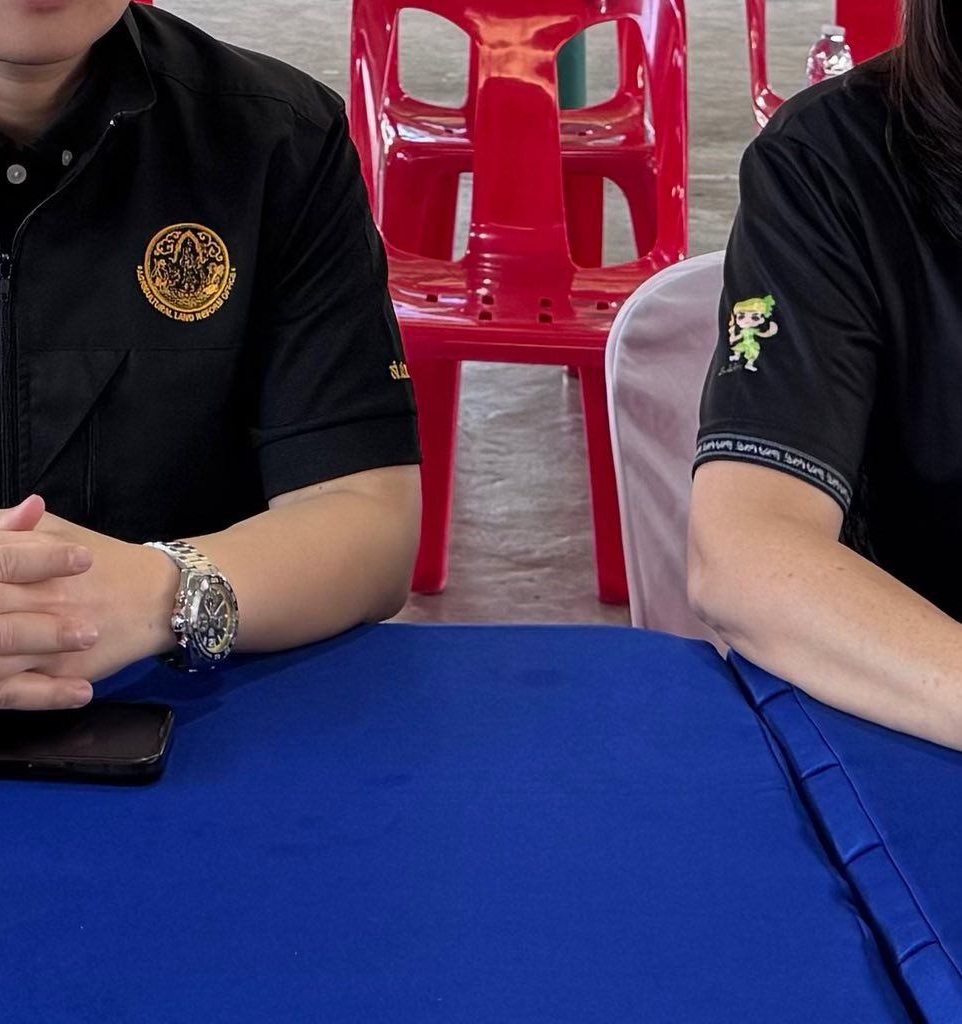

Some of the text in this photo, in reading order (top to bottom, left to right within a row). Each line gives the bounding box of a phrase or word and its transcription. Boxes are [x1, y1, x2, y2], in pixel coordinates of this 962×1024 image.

[136, 269, 173, 319] AGRICULTURAL
[174, 311, 195, 322] LAND
[195, 298, 224, 321] REFORM
